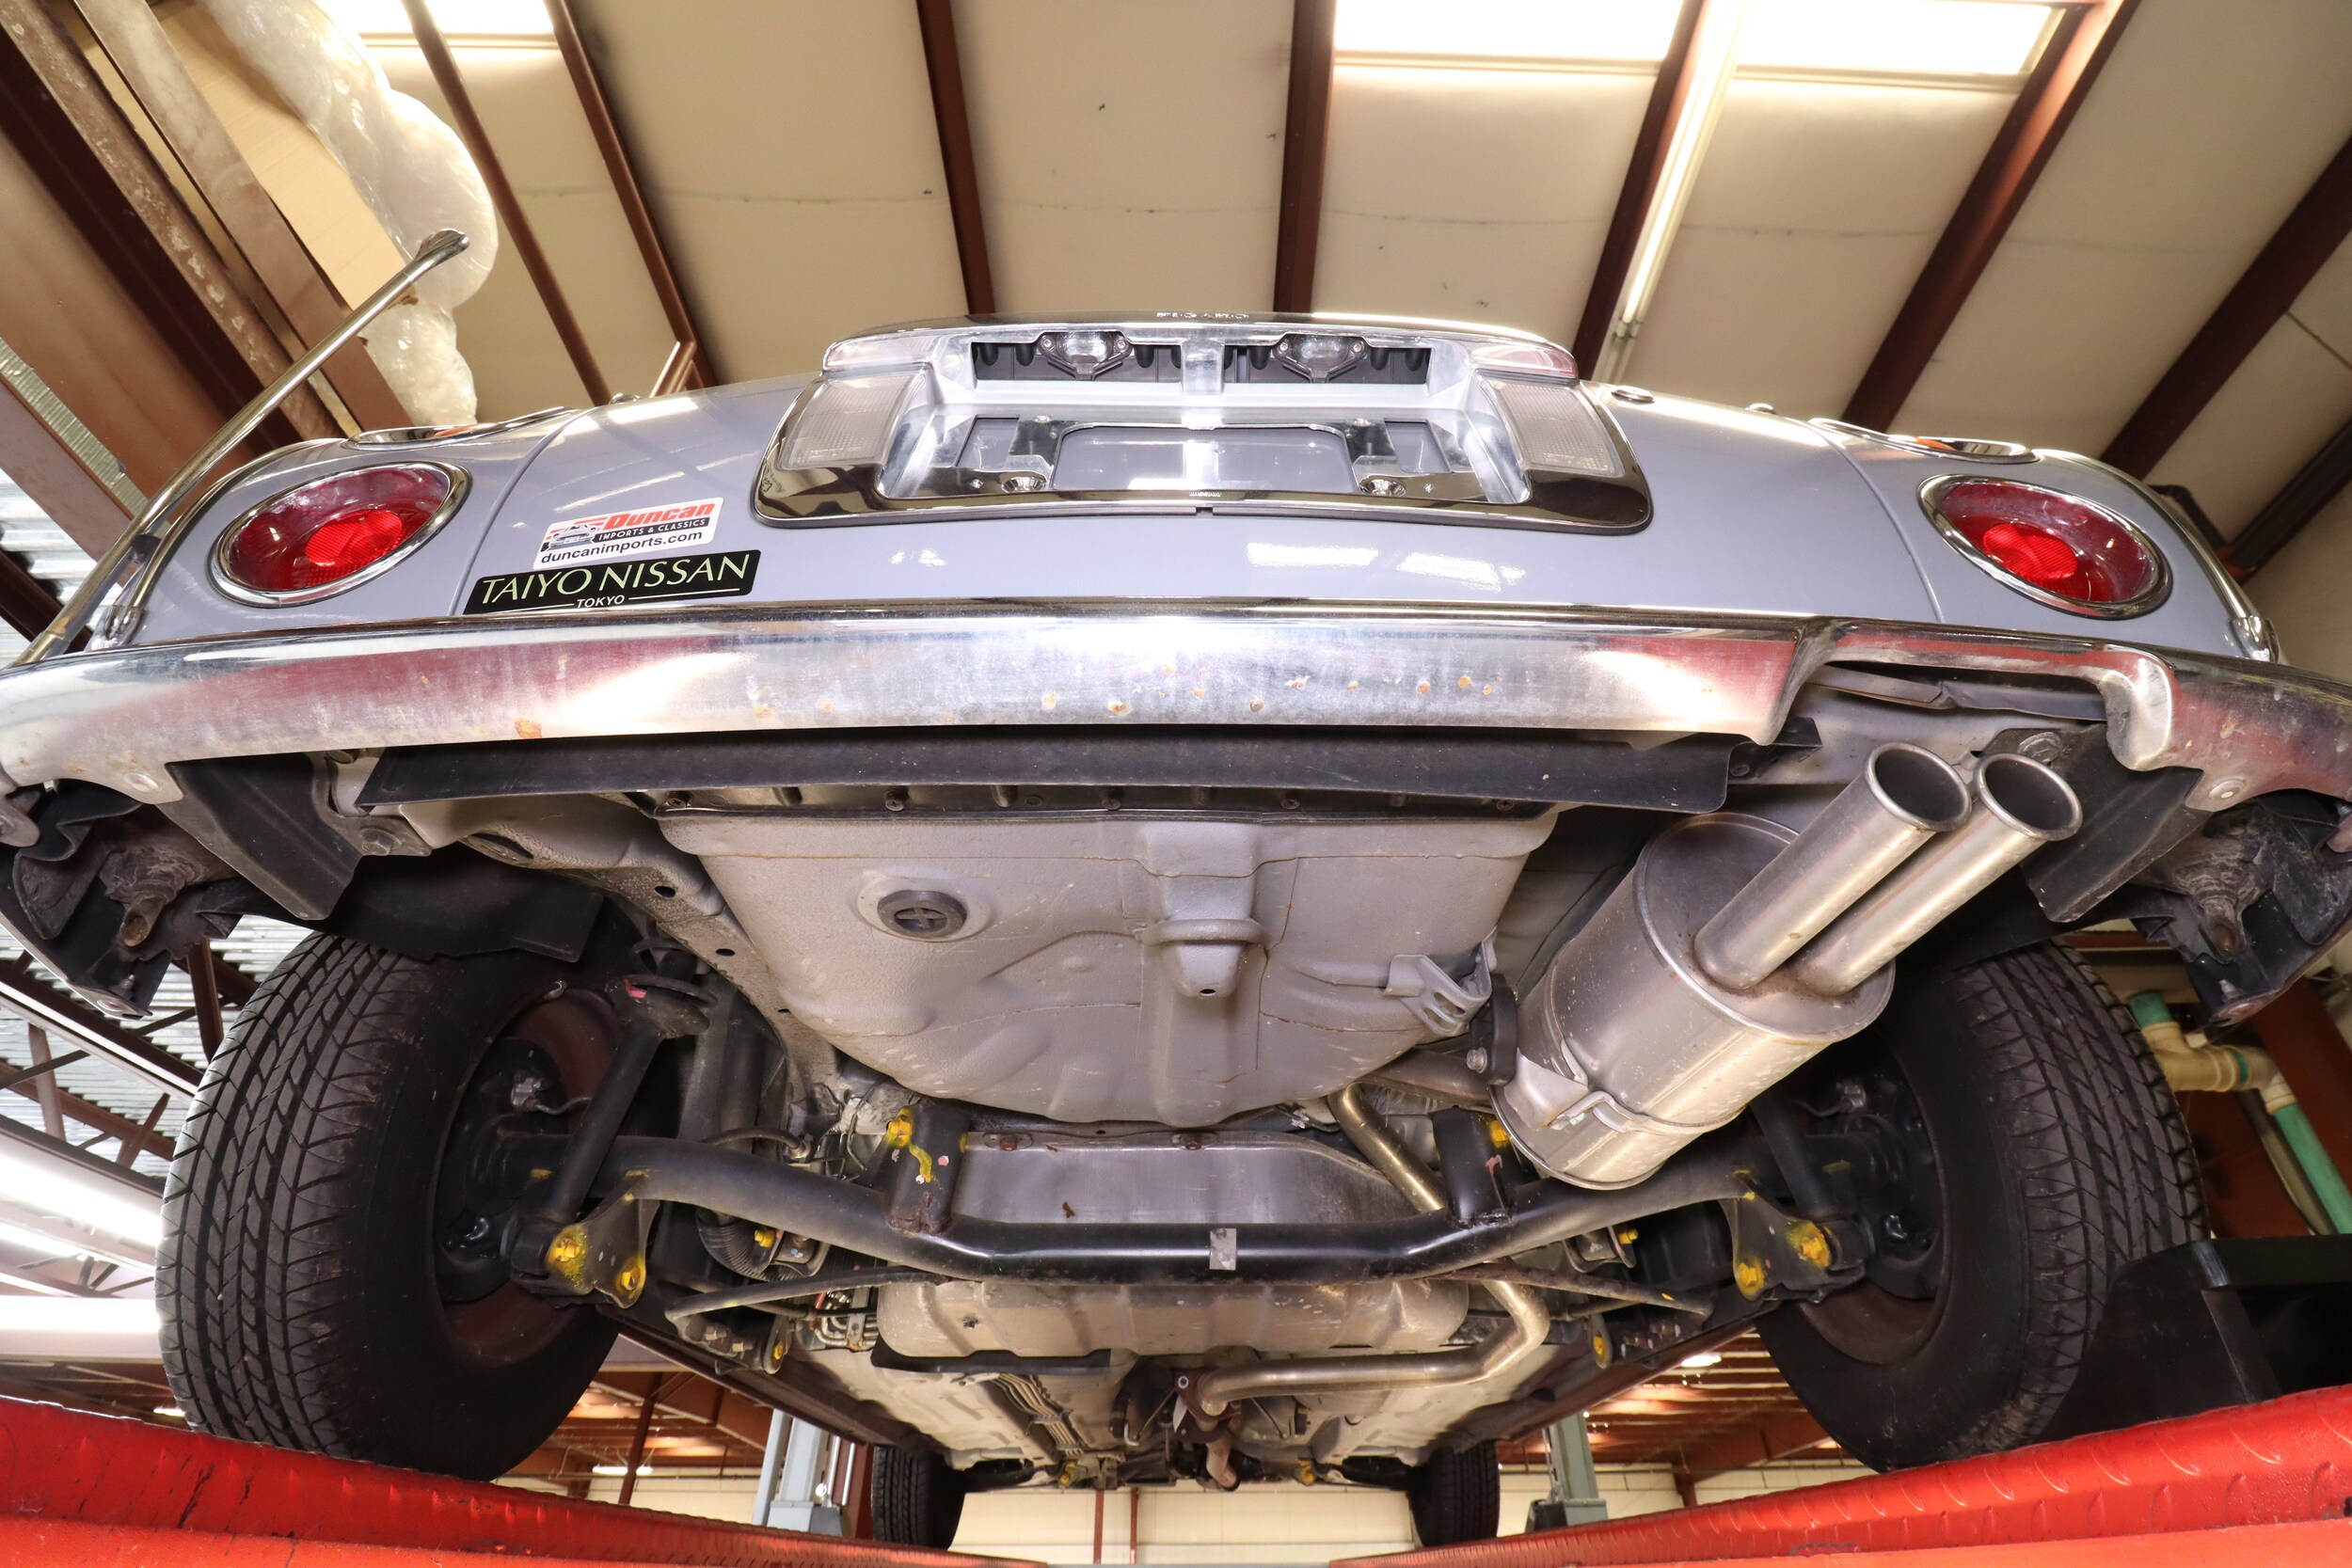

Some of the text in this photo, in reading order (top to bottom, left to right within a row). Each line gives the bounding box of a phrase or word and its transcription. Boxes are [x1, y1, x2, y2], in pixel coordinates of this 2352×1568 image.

[598, 527, 644, 541] IMPORTS
[658, 517, 706, 532] CLASSICS
[603, 502, 715, 530] Duncan
[541, 532, 703, 563] duncanimports.com
[482, 553, 750, 605] TAIYO NISSAN
[576, 594, 626, 609] TOKYO
